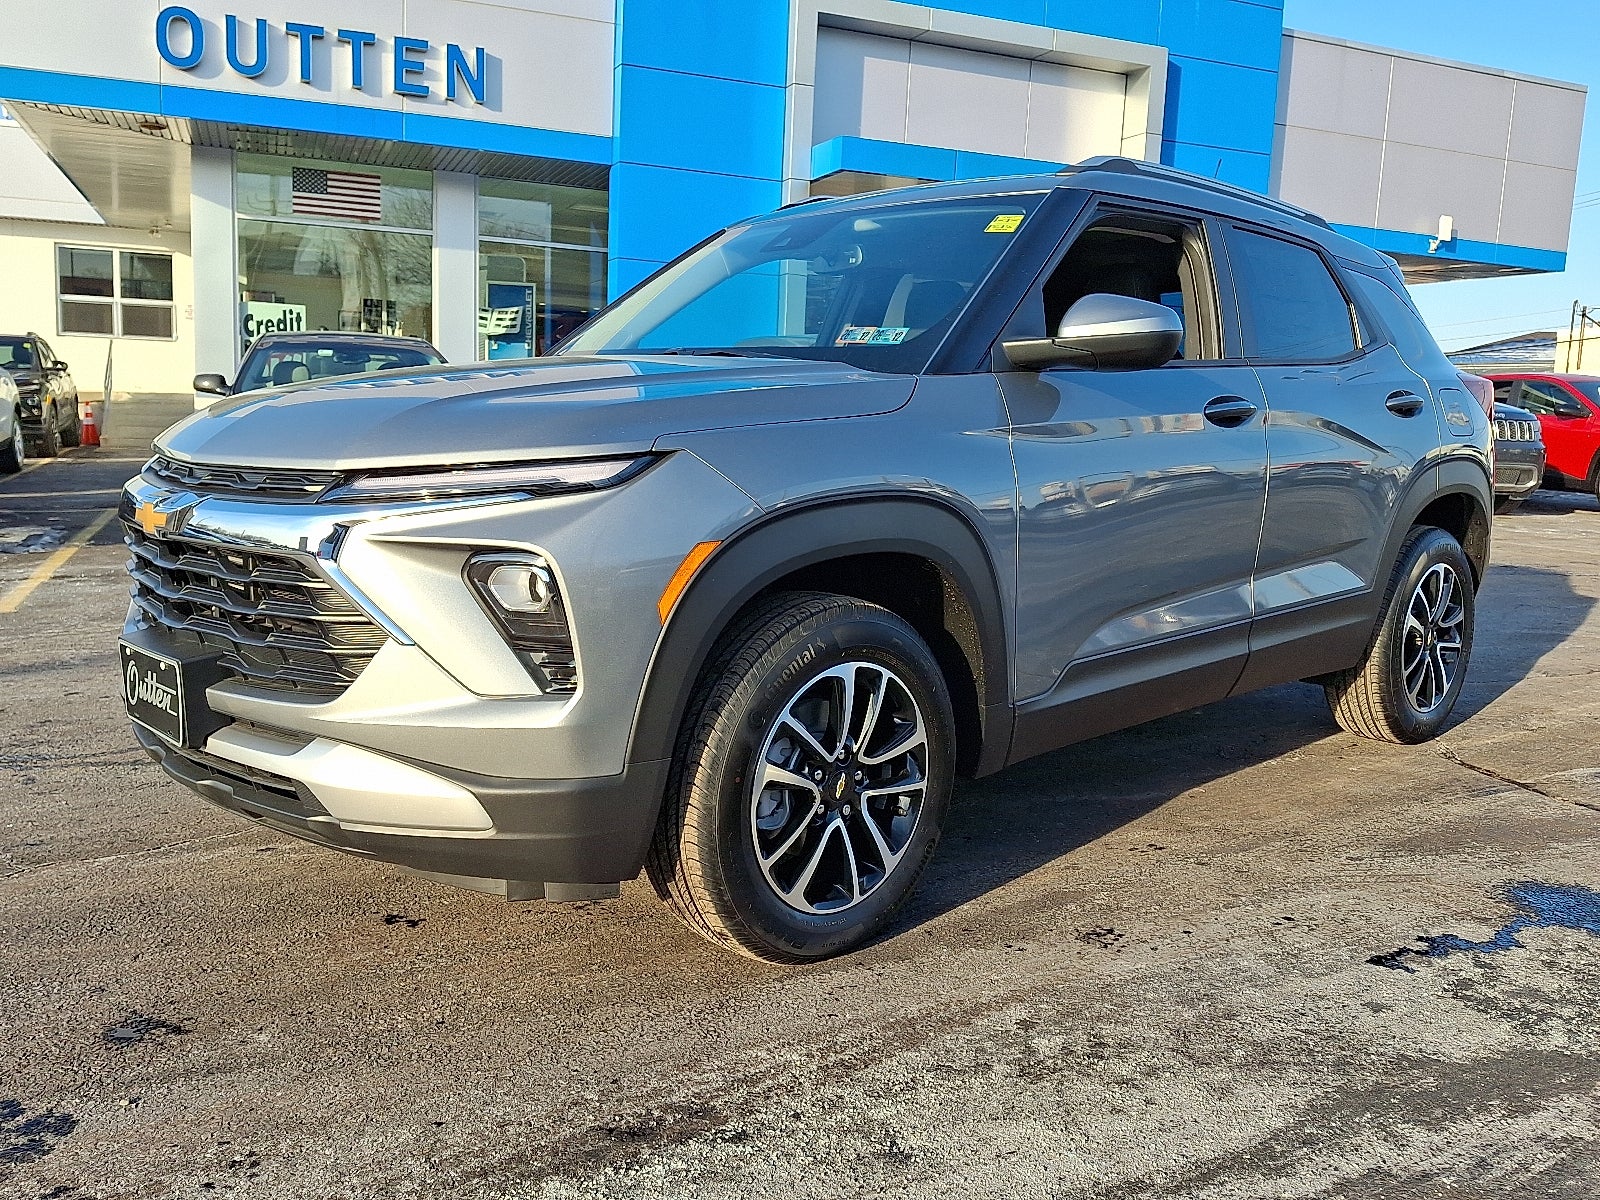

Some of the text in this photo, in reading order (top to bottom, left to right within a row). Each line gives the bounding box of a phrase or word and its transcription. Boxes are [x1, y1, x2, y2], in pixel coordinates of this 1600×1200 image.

[156, 5, 487, 104] OUTTEN
[243, 309, 302, 337] Credit
[524, 288, 533, 349] CHEVROLET
[891, 331, 904, 342] 12
[126, 660, 178, 717] Outten
